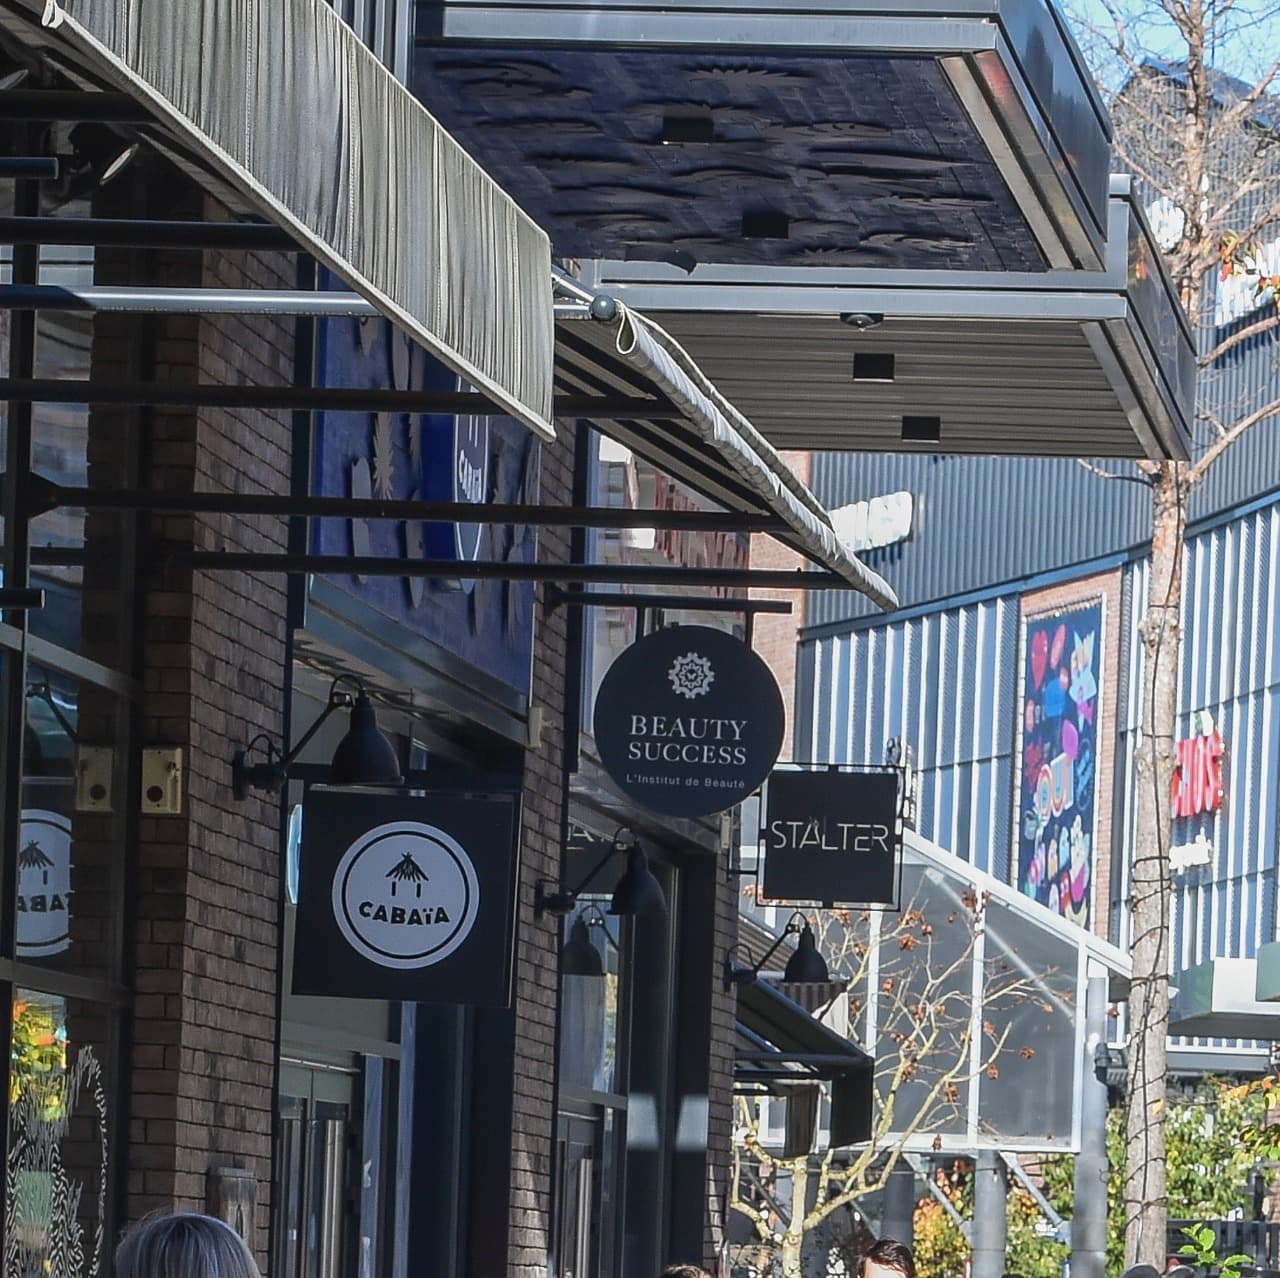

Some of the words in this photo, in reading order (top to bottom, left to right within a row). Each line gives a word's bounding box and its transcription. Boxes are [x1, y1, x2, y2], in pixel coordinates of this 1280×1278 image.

[629, 714, 748, 741] BEAUTY
[628, 741, 747, 765] SUCCESS
[626, 773, 680, 785] L'Institut
[685, 777, 700, 786] de
[704, 778, 745, 789] Beauté
[771, 819, 889, 852] STALTER
